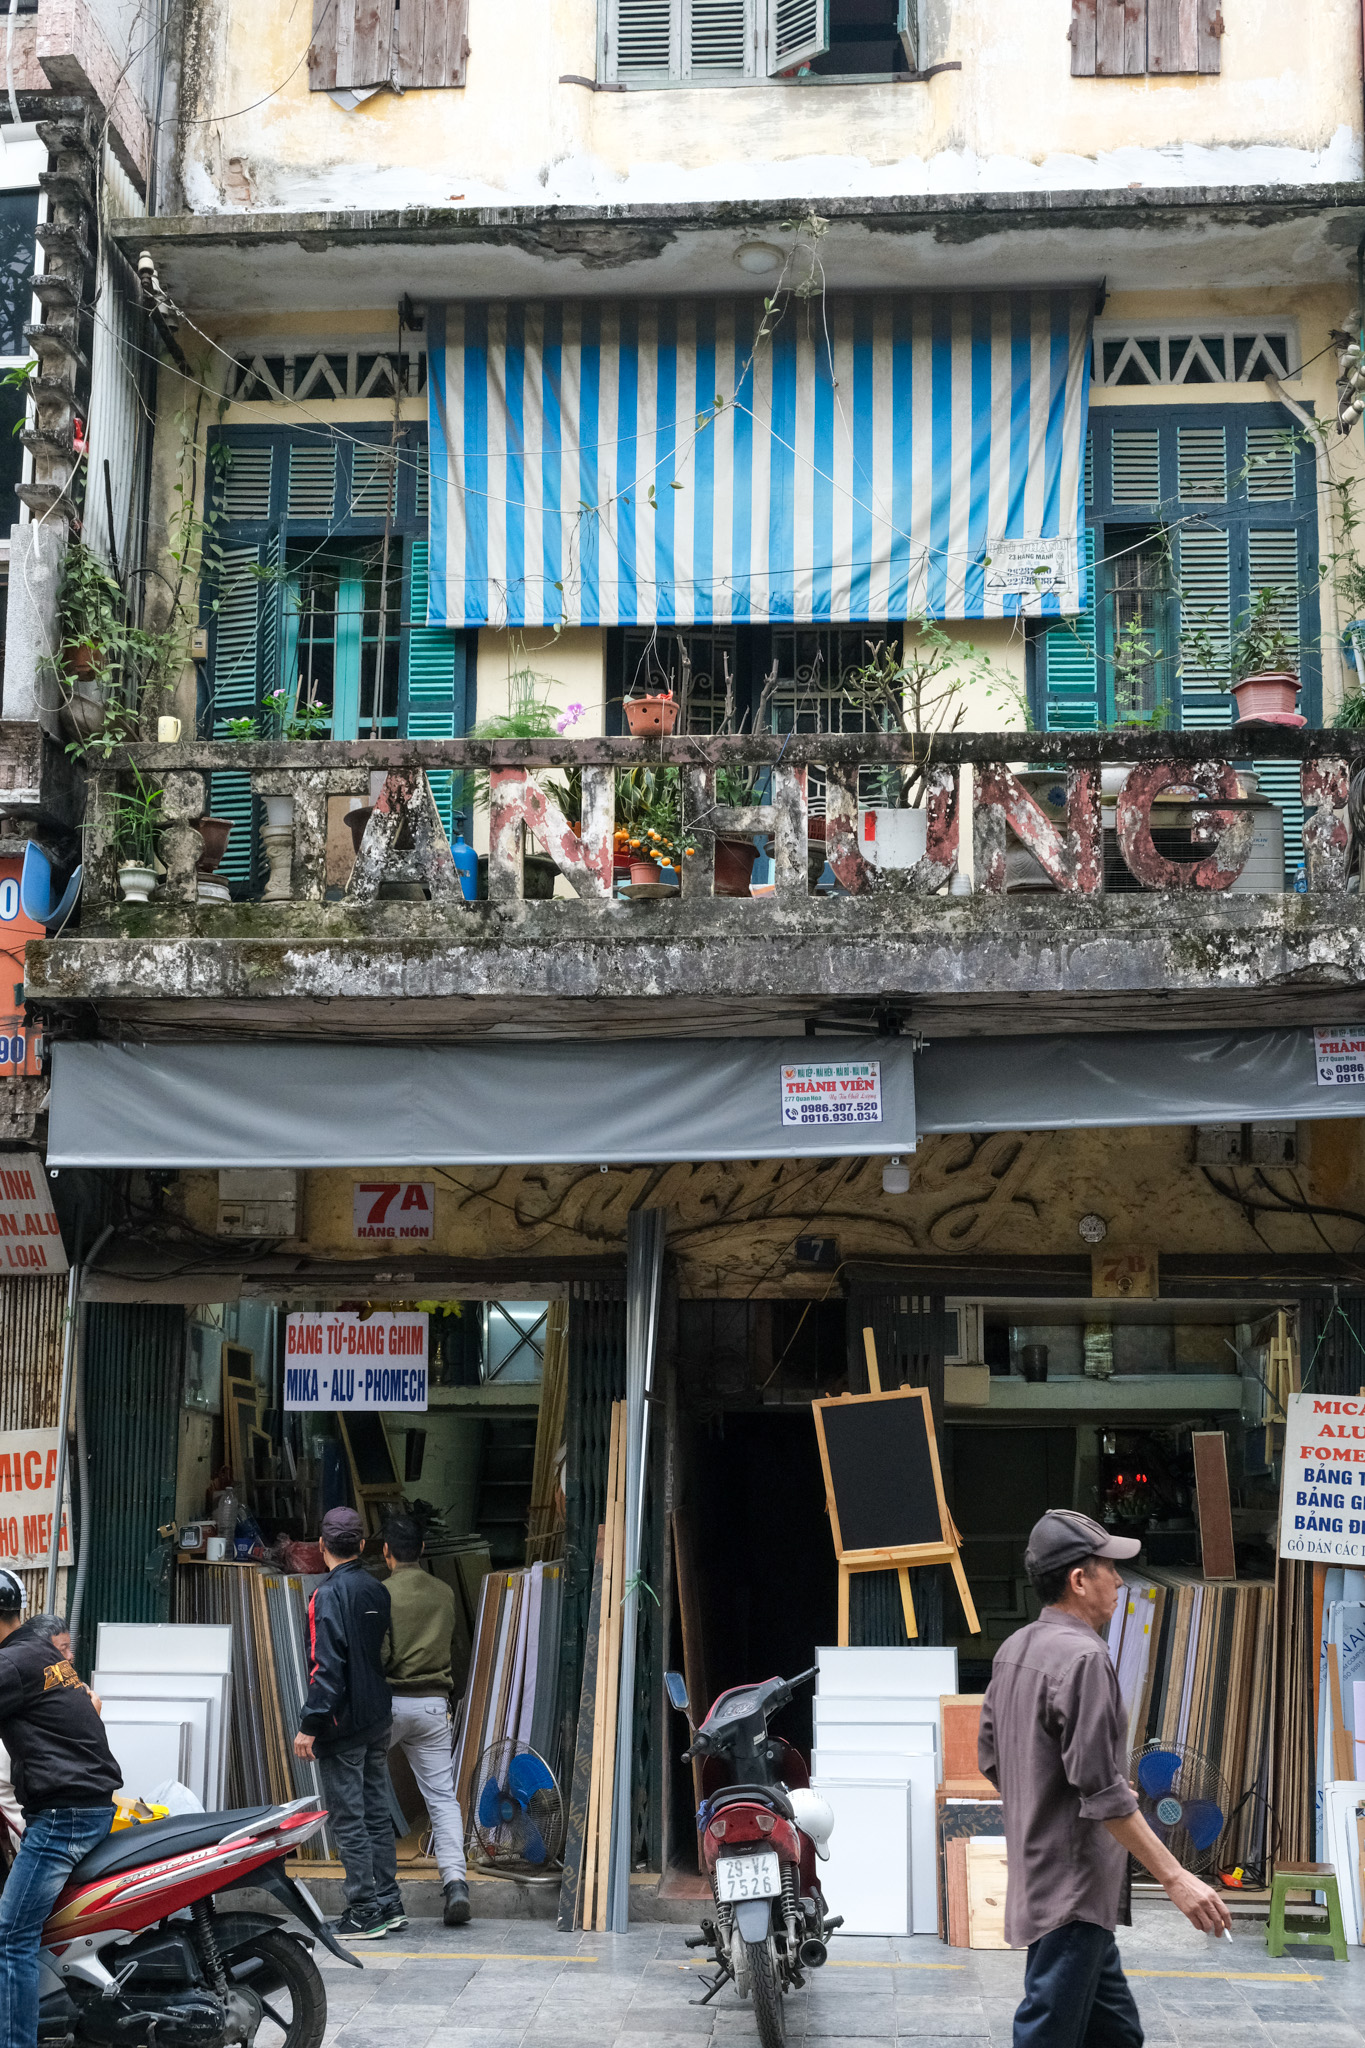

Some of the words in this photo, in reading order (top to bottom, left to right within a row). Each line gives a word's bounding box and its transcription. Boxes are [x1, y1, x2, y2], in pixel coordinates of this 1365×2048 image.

[786, 1079, 836, 1093] THÀNH
[839, 1077, 875, 1091] VIÊN
[801, 1102, 878, 1113] 0986.307.520
[801, 1112, 878, 1123] 0916.930.034
[360, 1184, 429, 1224] 7A
[0, 1213, 60, 1237] N.ALU
[357, 1225, 395, 1238] HÀNG
[400, 1225, 429, 1238] NÓN
[5, 1245, 47, 1271] LOẠI
[811, 1240, 824, 1261] 7
[288, 1314, 323, 1355] BẢNG
[388, 1325, 423, 1355] GHIM
[286, 1369, 318, 1401] MIKA
[330, 1369, 354, 1401] ALU
[364, 1369, 426, 1402] PHOMECH
[1304, 1463, 1352, 1486] BẢNG
[1296, 1486, 1345, 1510] BẢNG
[1294, 1510, 1343, 1533] BẢNG
[1307, 1538, 1332, 1554] DÁN
[1335, 1541, 1359, 1557] CÁC
[726, 1856, 769, 1879] 29-V4
[727, 1876, 772, 1899] 7526
